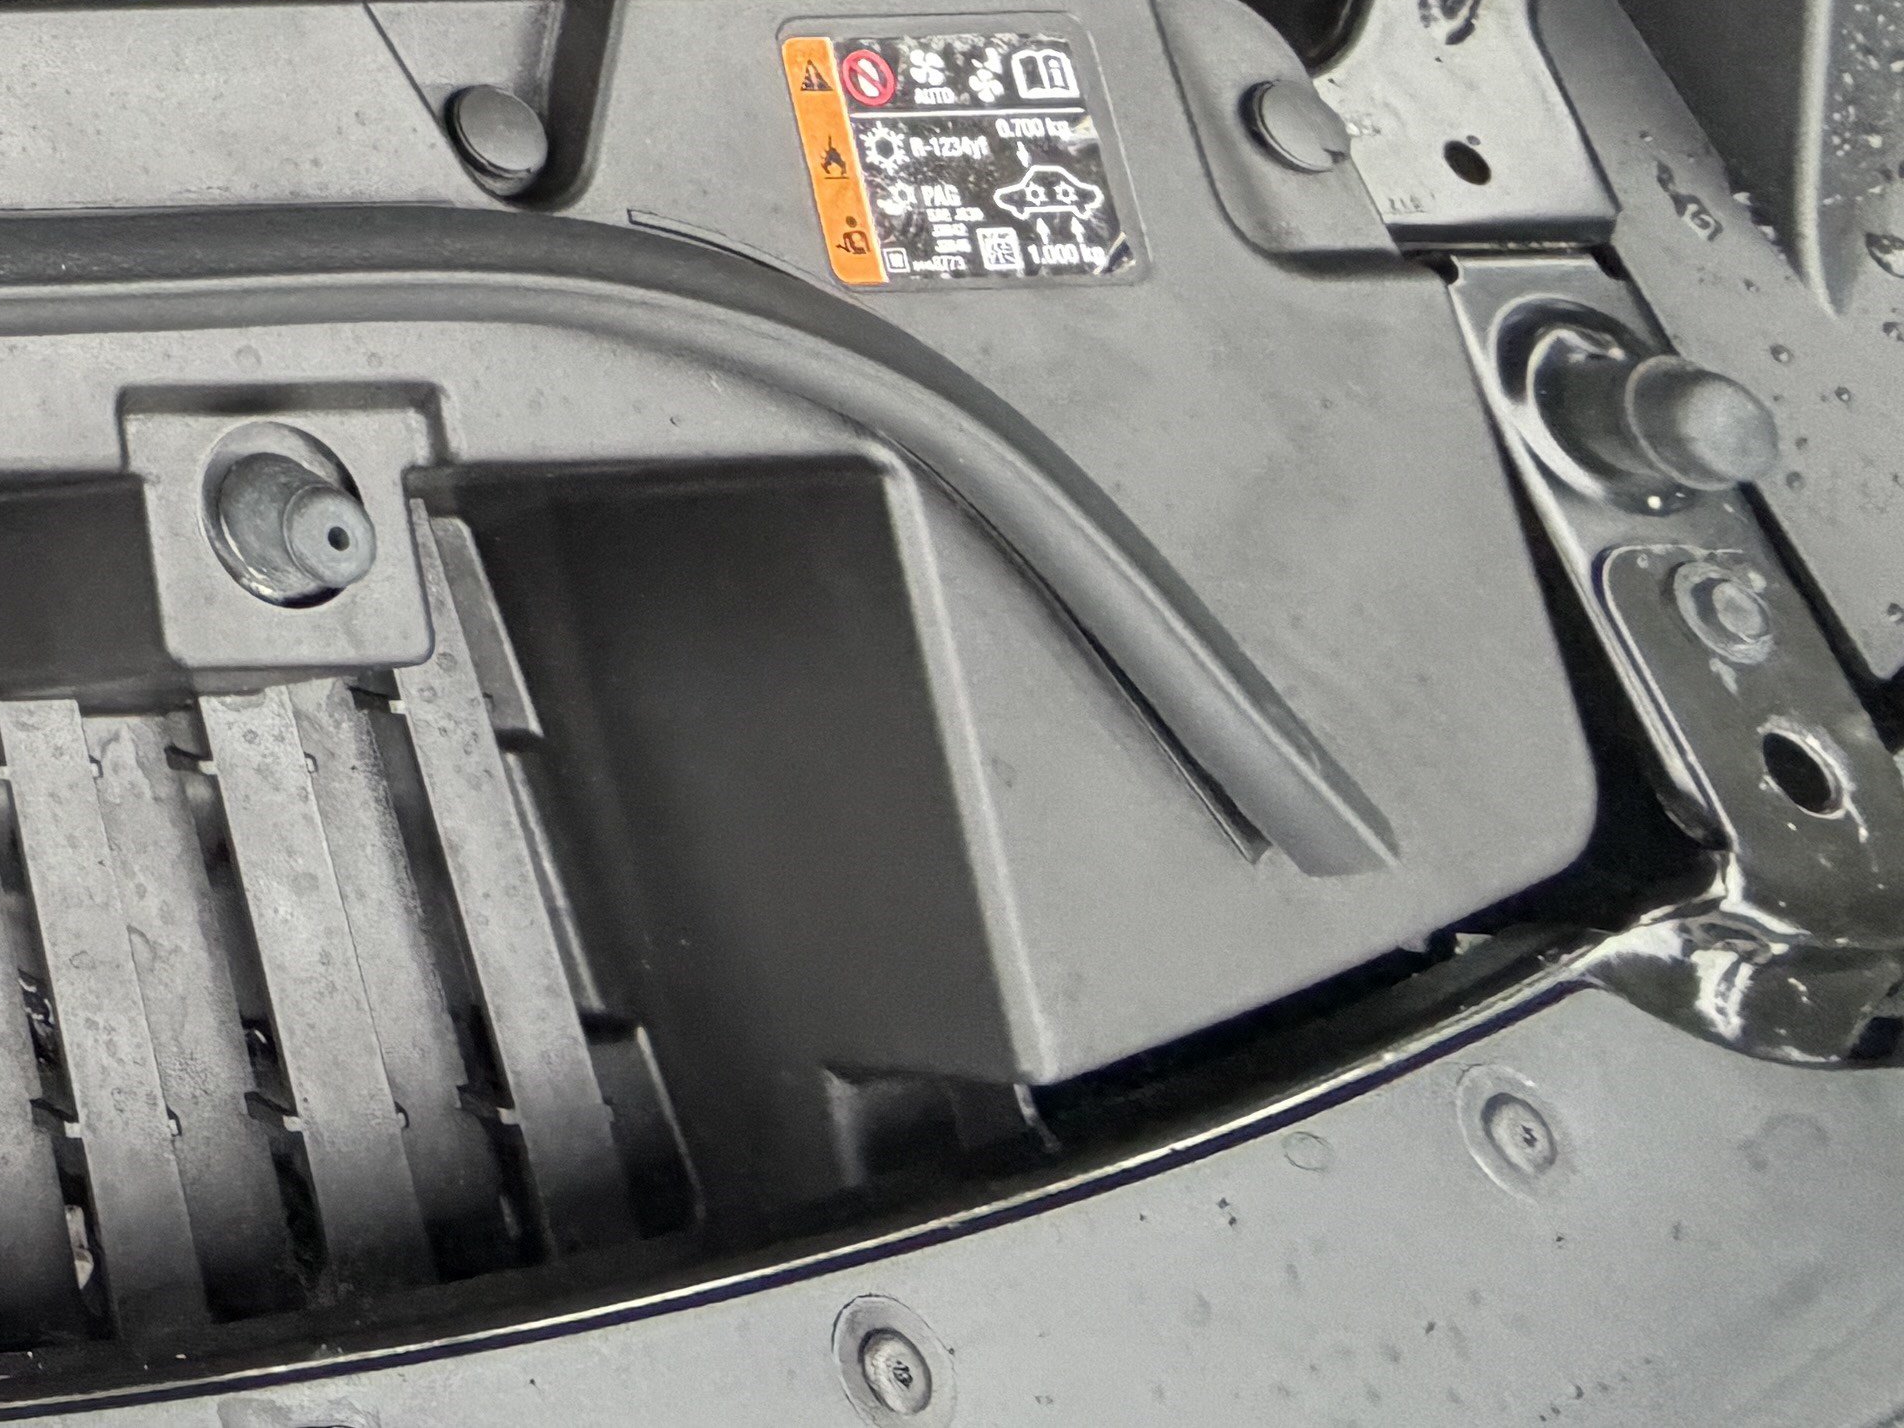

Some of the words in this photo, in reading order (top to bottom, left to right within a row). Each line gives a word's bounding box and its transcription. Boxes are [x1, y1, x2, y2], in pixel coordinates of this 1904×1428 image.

[995, 117, 1044, 140] 0.700
[910, 135, 988, 159] R-1234yf
[921, 184, 961, 207] PAG
[1028, 243, 1076, 265] 1.000
